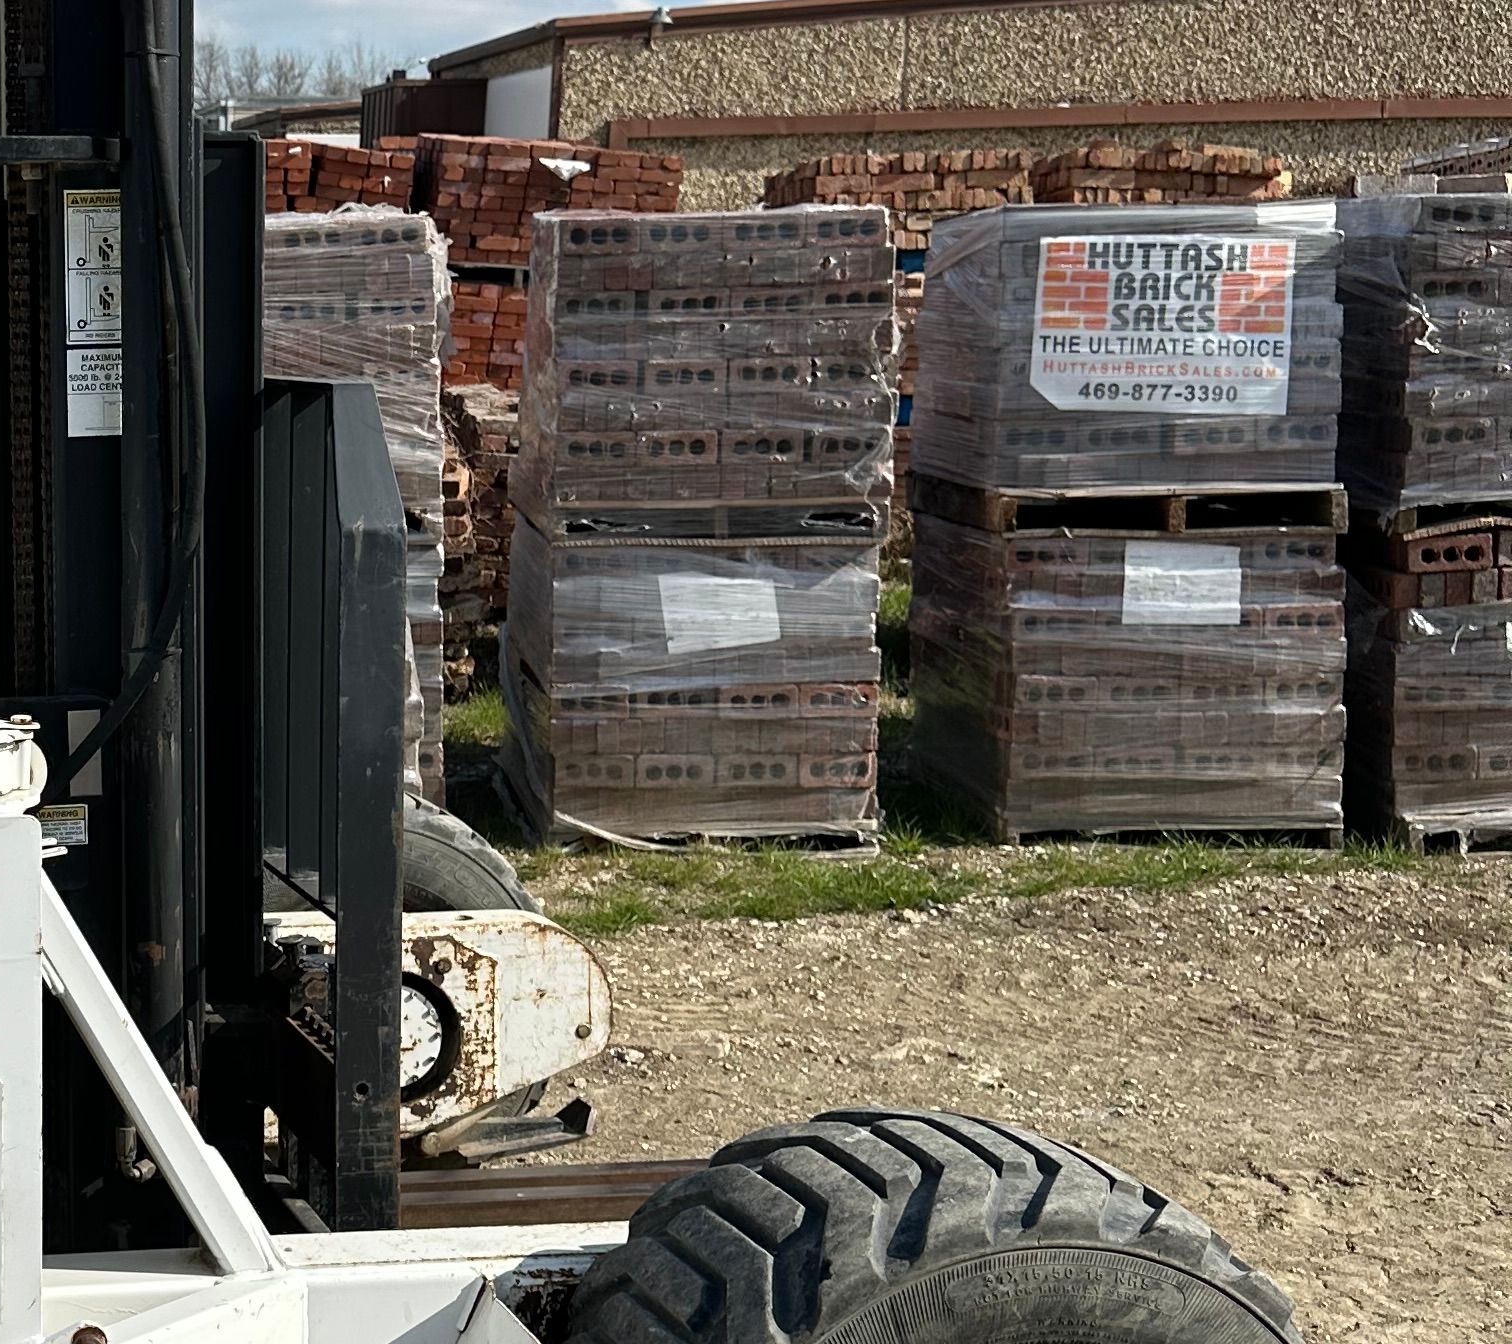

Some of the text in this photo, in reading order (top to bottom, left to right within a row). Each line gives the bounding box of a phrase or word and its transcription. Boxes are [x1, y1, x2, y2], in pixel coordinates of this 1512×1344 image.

[1087, 242, 1248, 271] HUTTASH
[1114, 272, 1219, 302] BRICK
[1110, 304, 1215, 332] SALES
[1040, 335, 1285, 358] THE ULTIMATE CHOICE
[81, 363, 122, 371] CAPACIT
[1078, 382, 1238, 403] 469-877-3390
